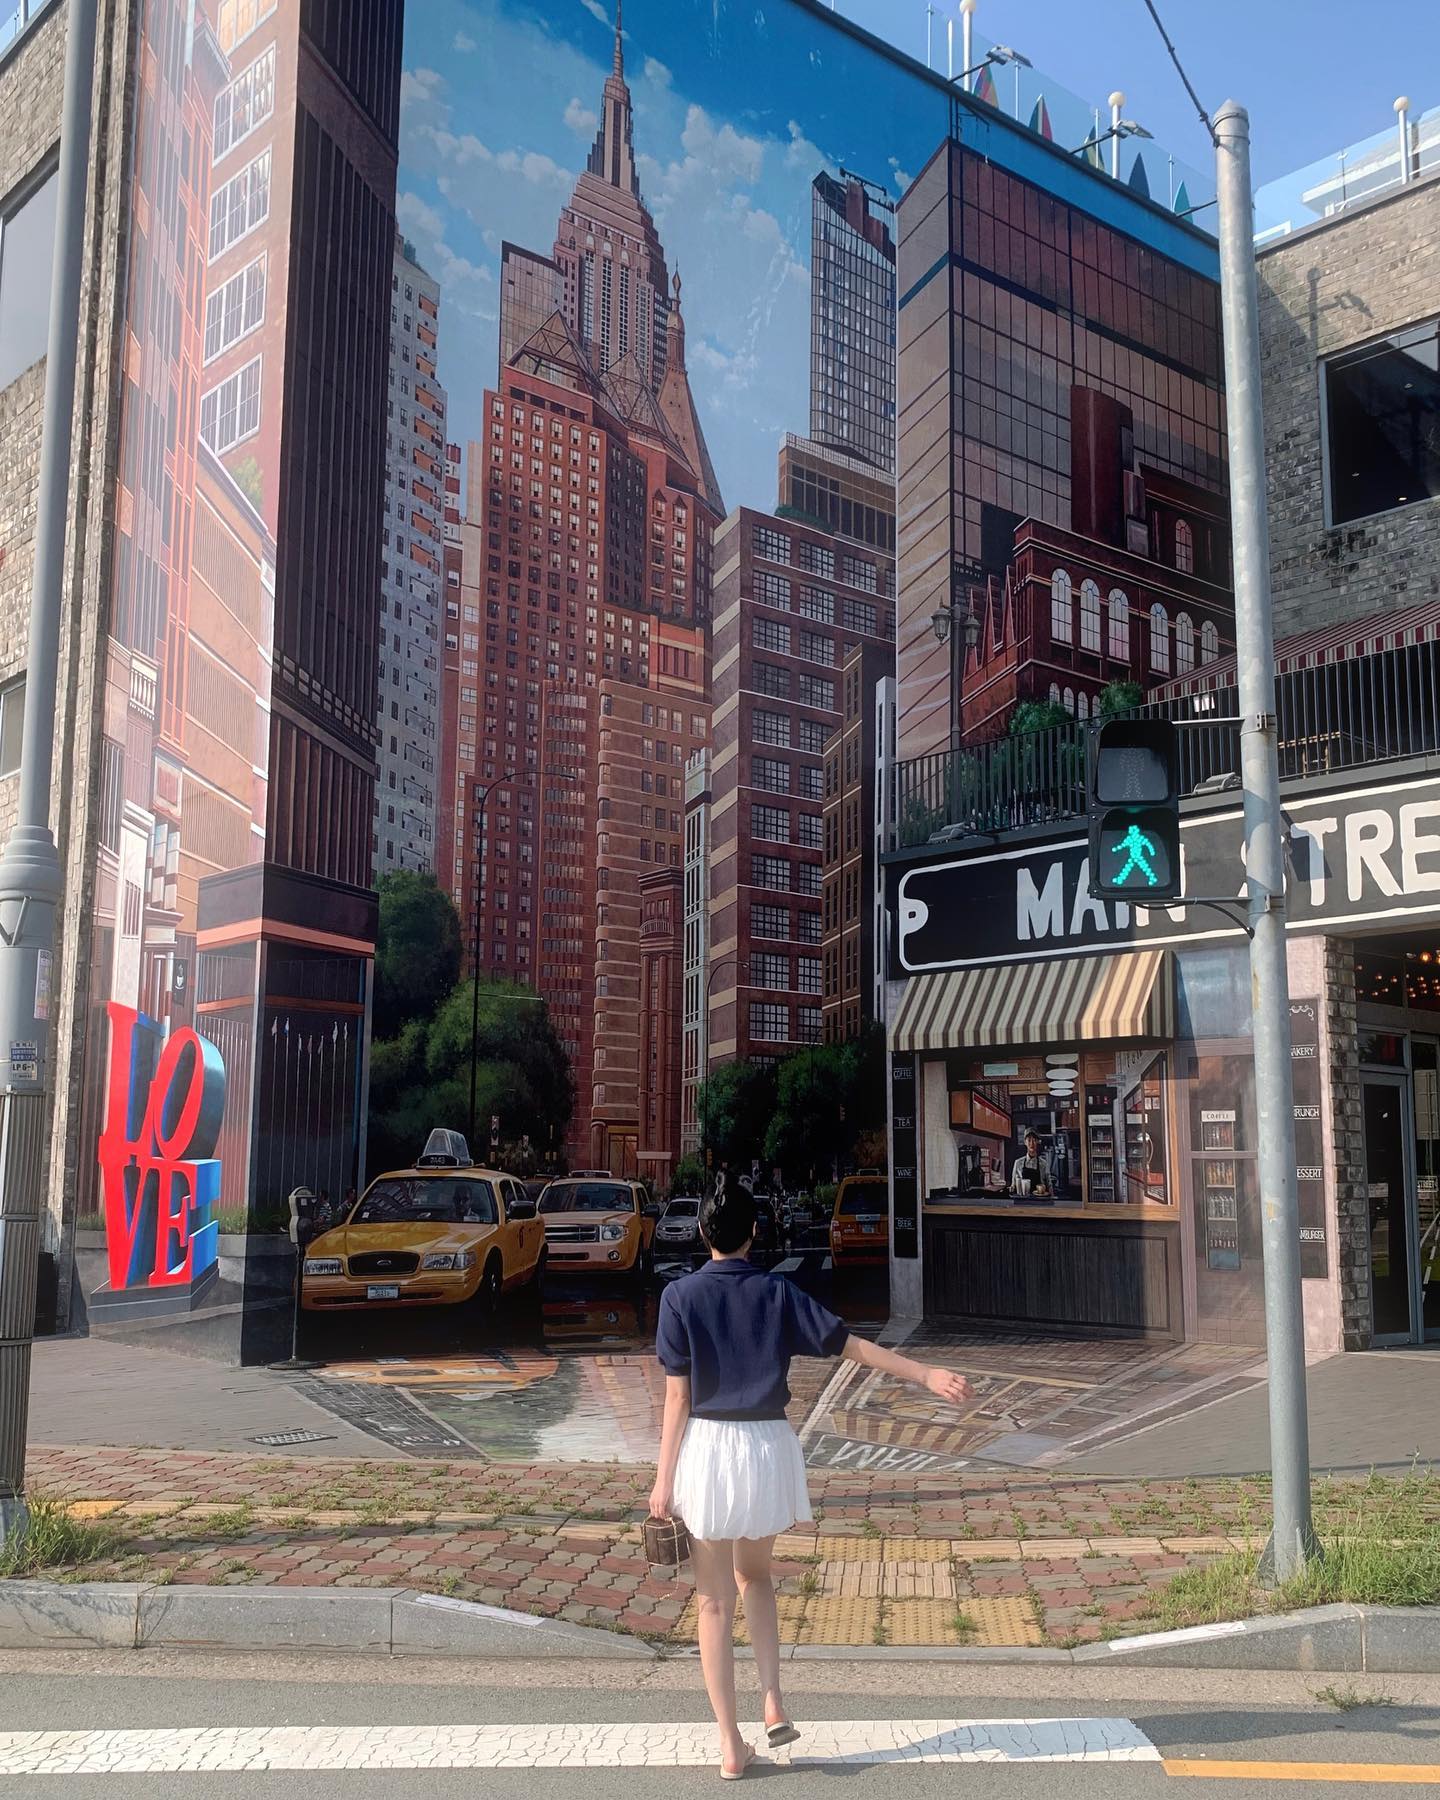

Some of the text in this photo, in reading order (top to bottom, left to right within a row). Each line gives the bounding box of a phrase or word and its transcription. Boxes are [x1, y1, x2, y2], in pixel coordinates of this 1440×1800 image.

[1237, 800, 1440, 906] TRE
[1291, 1046, 1315, 1057] AKERY
[1293, 1108, 1320, 1118] RUNCH
[897, 1118, 911, 1127] TEA
[897, 1168, 912, 1177] WINE
[1296, 1168, 1322, 1178] ESSERT
